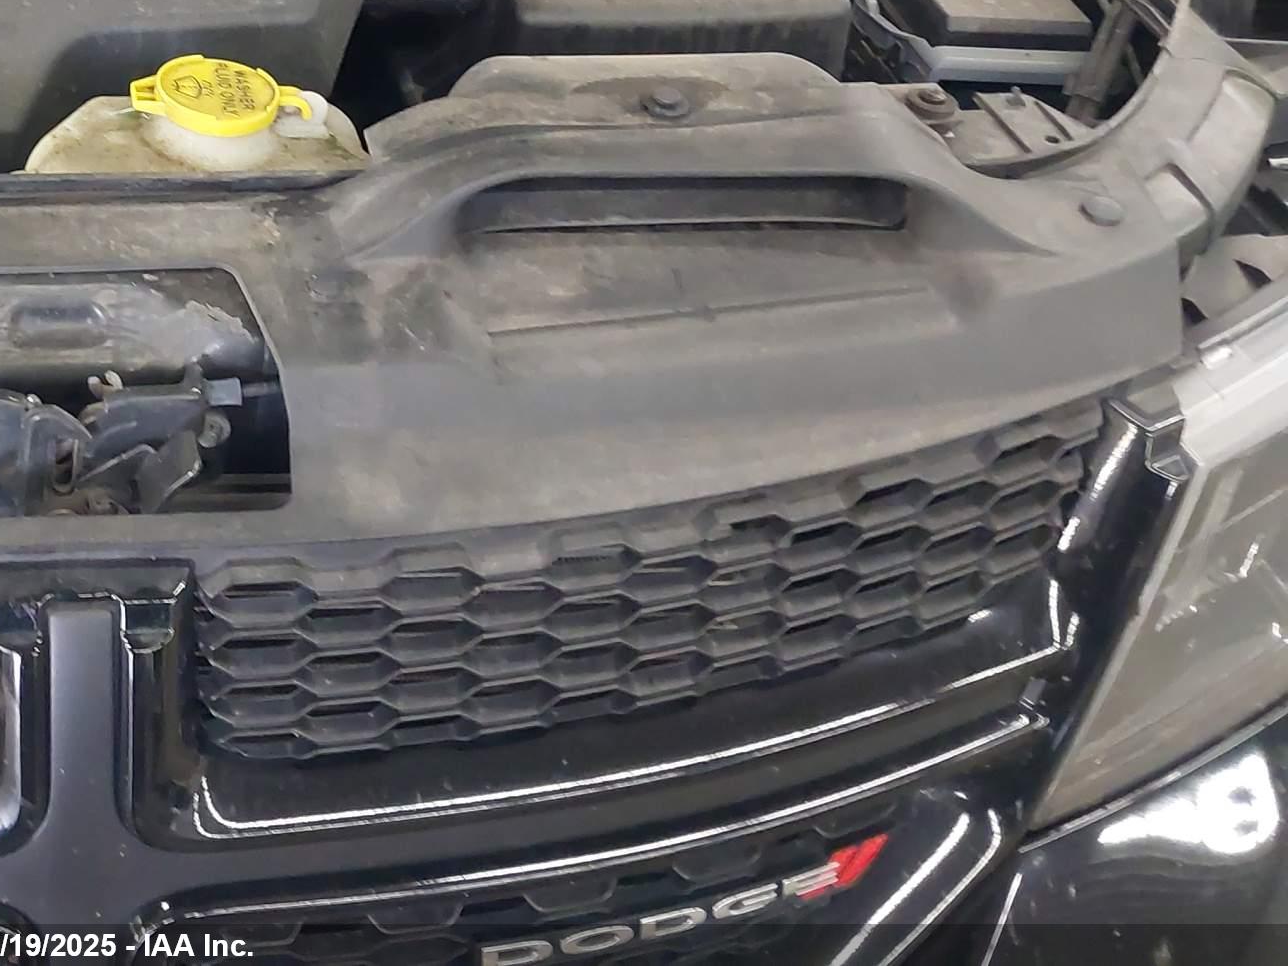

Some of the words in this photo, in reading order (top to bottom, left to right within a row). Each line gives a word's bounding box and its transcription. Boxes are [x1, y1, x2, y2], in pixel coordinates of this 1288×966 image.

[215, 62, 232, 90] FLUID
[233, 69, 256, 112] WASHER
[221, 90, 240, 118] ONLY
[481, 861, 842, 966] DODGE
